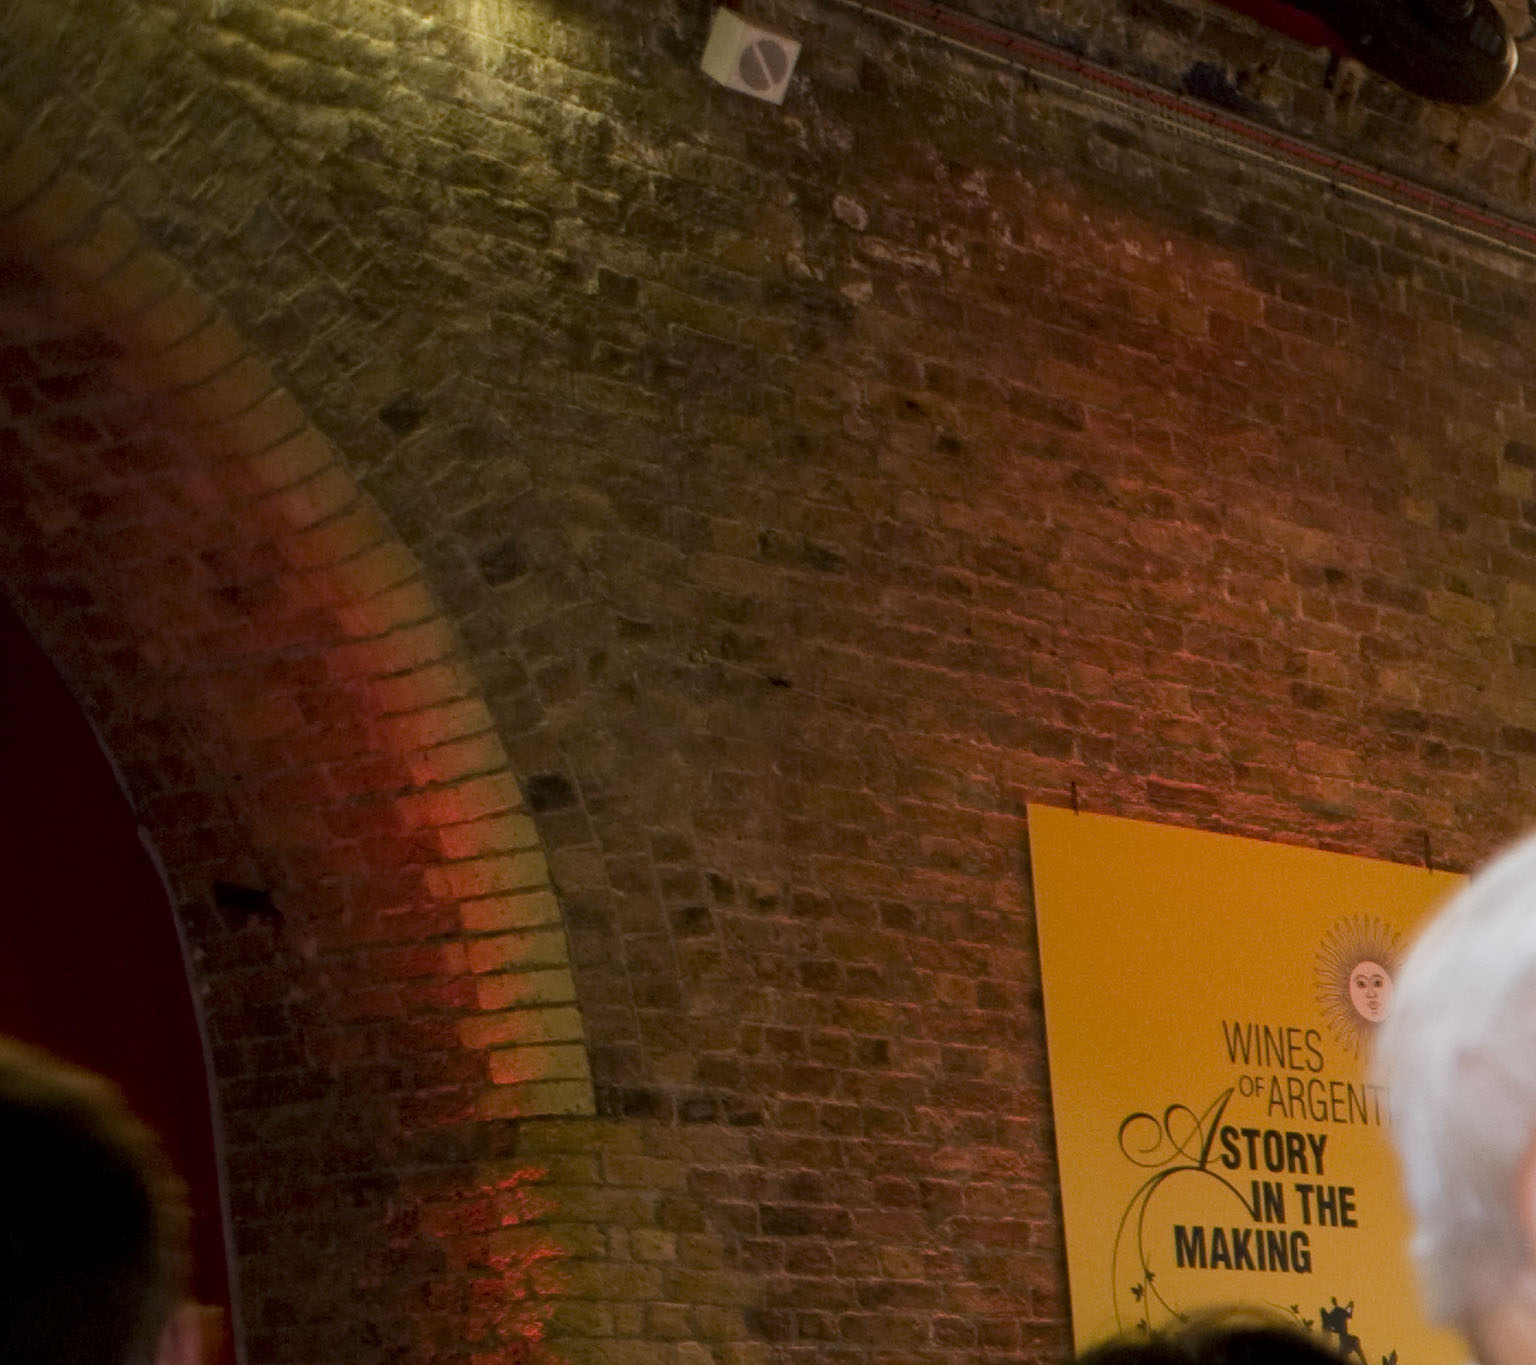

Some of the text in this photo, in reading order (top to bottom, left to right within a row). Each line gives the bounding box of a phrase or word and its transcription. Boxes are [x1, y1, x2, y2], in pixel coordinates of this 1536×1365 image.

[1222, 1020, 1324, 1073] WINES
[1239, 1075, 1392, 1126] OF ARGENTI
[1221, 1126, 1327, 1175] STORY
[1251, 1180, 1358, 1229] IN THE
[1174, 1224, 1312, 1273] MAKING
